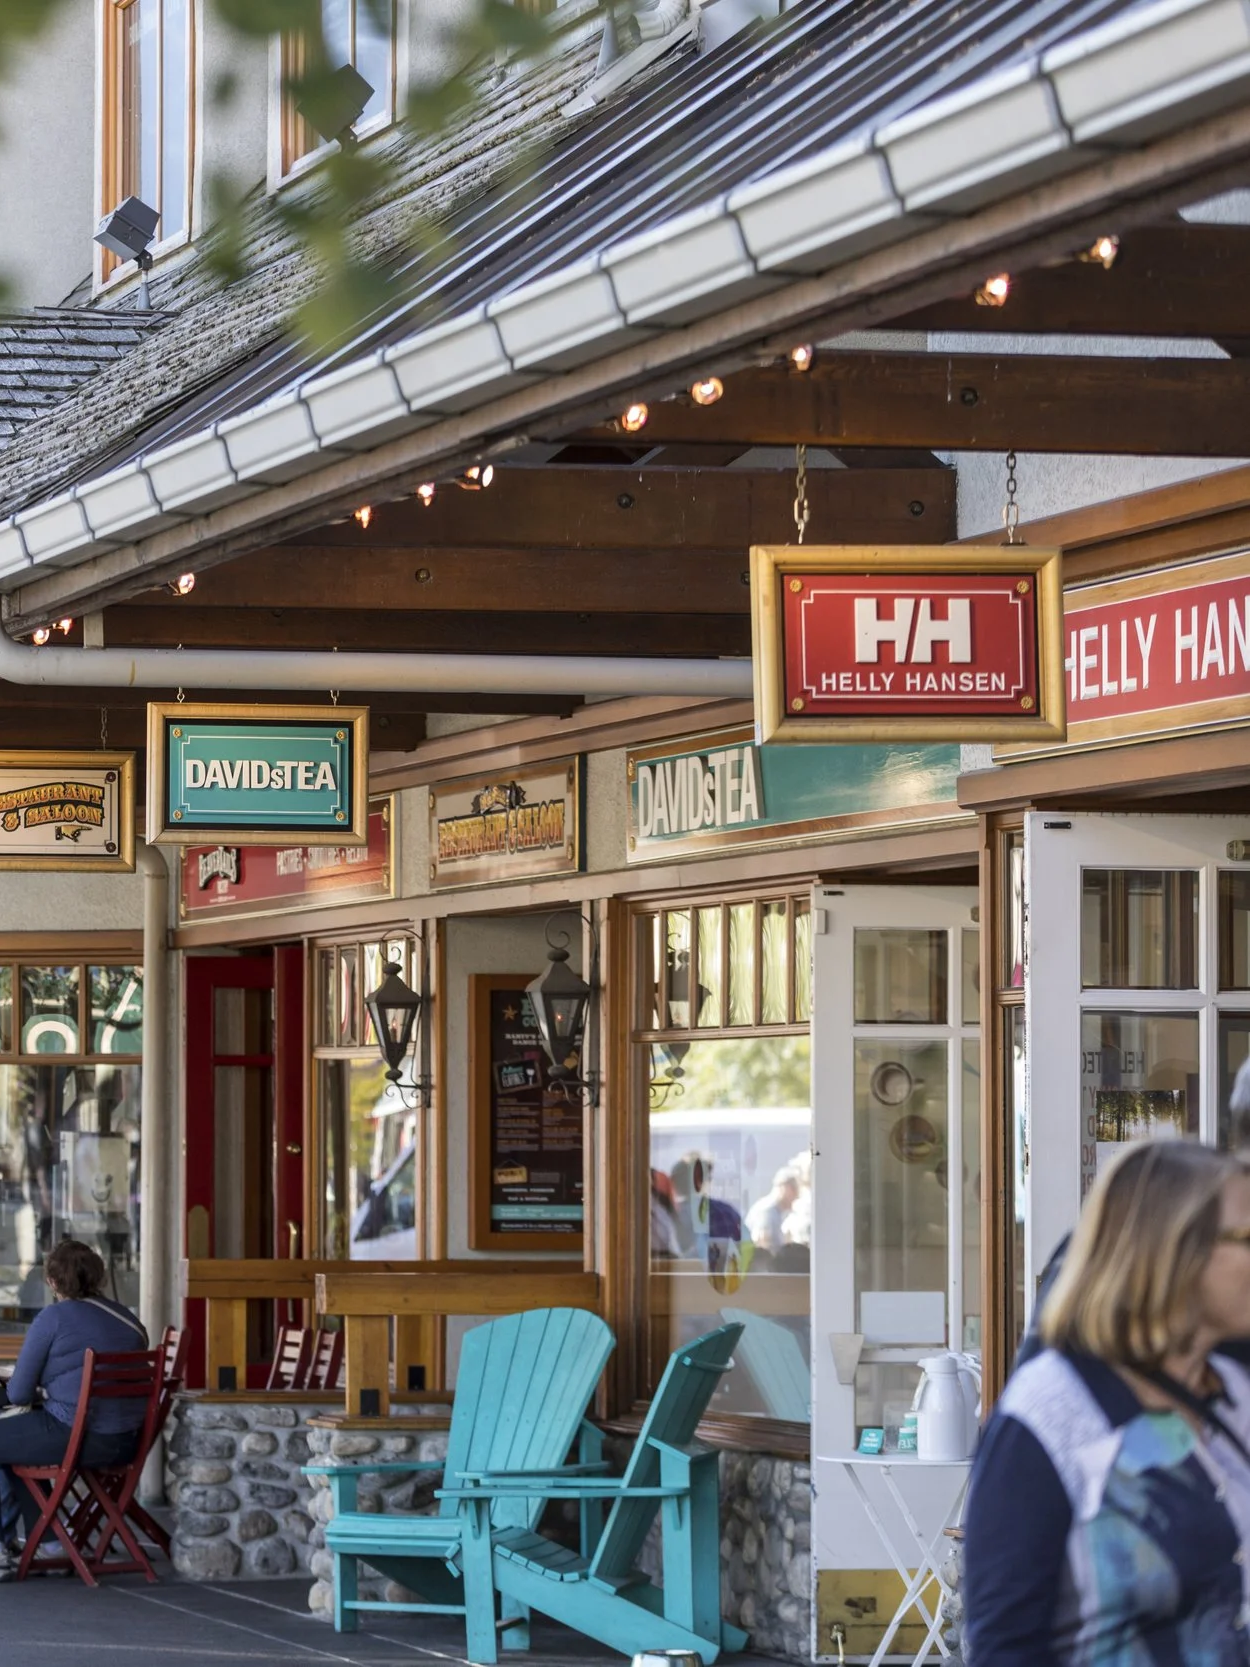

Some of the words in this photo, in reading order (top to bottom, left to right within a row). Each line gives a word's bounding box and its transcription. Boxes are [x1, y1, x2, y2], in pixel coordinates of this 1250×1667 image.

[1065, 614, 1157, 702] HELLY
[821, 672, 894, 691] HELLY
[905, 672, 1005, 691] HANSEN
[186, 759, 337, 790] DAVIDsTEA
[638, 746, 759, 837] DAVIDsTEA
[2, 811, 20, 831] &
[25, 803, 104, 827] SALOON
